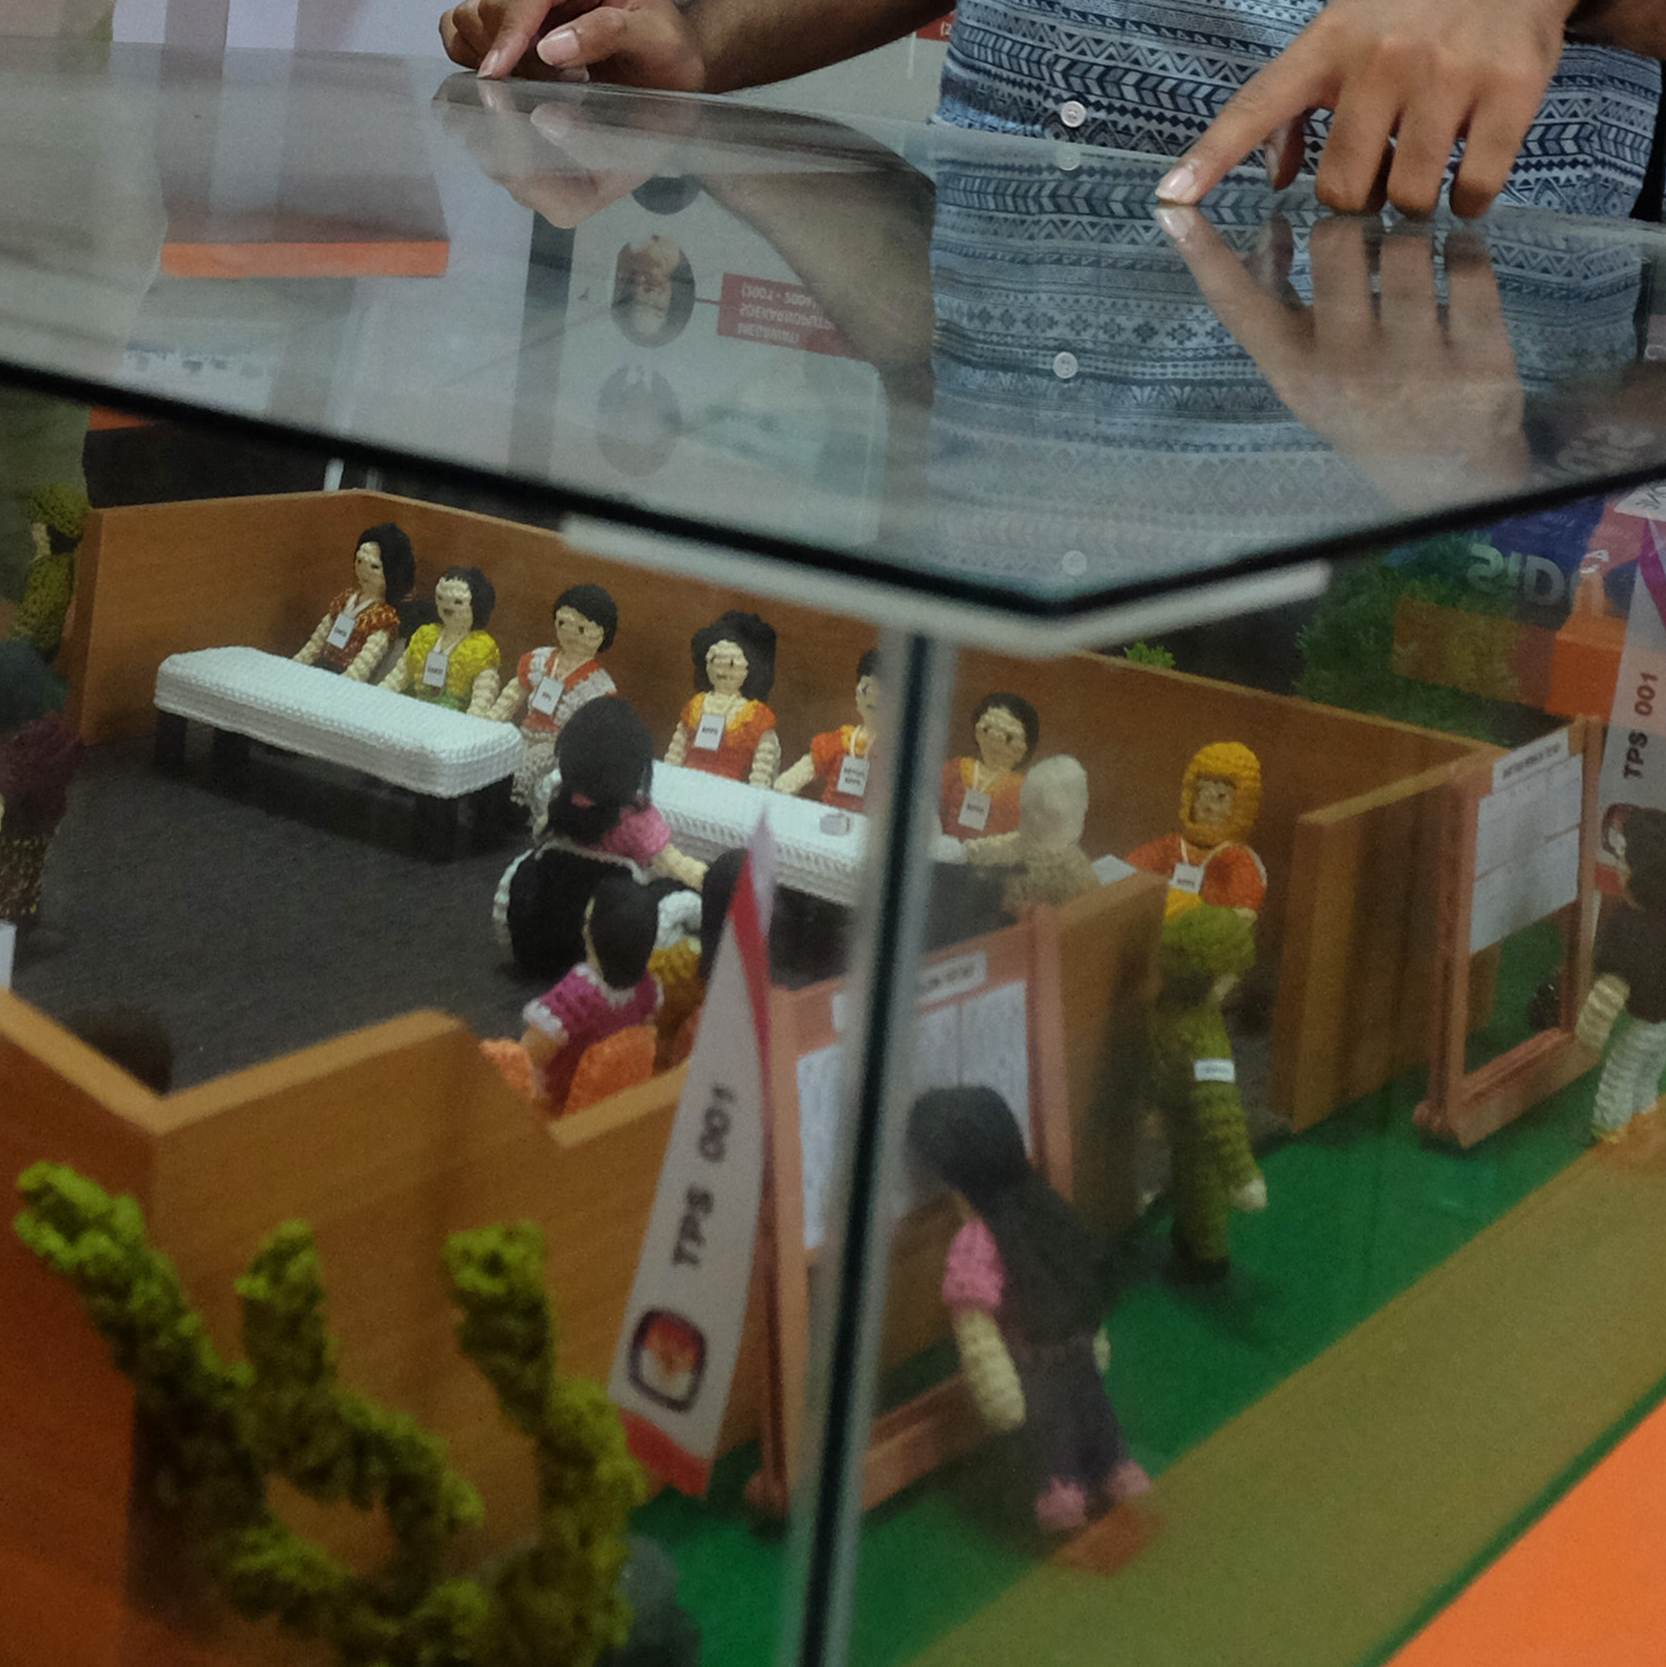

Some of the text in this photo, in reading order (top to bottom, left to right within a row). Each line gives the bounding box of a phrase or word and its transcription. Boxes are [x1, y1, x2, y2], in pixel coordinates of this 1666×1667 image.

[1622, 671, 1660, 780] TPS 001
[670, 1080, 740, 1269] TPS 001
